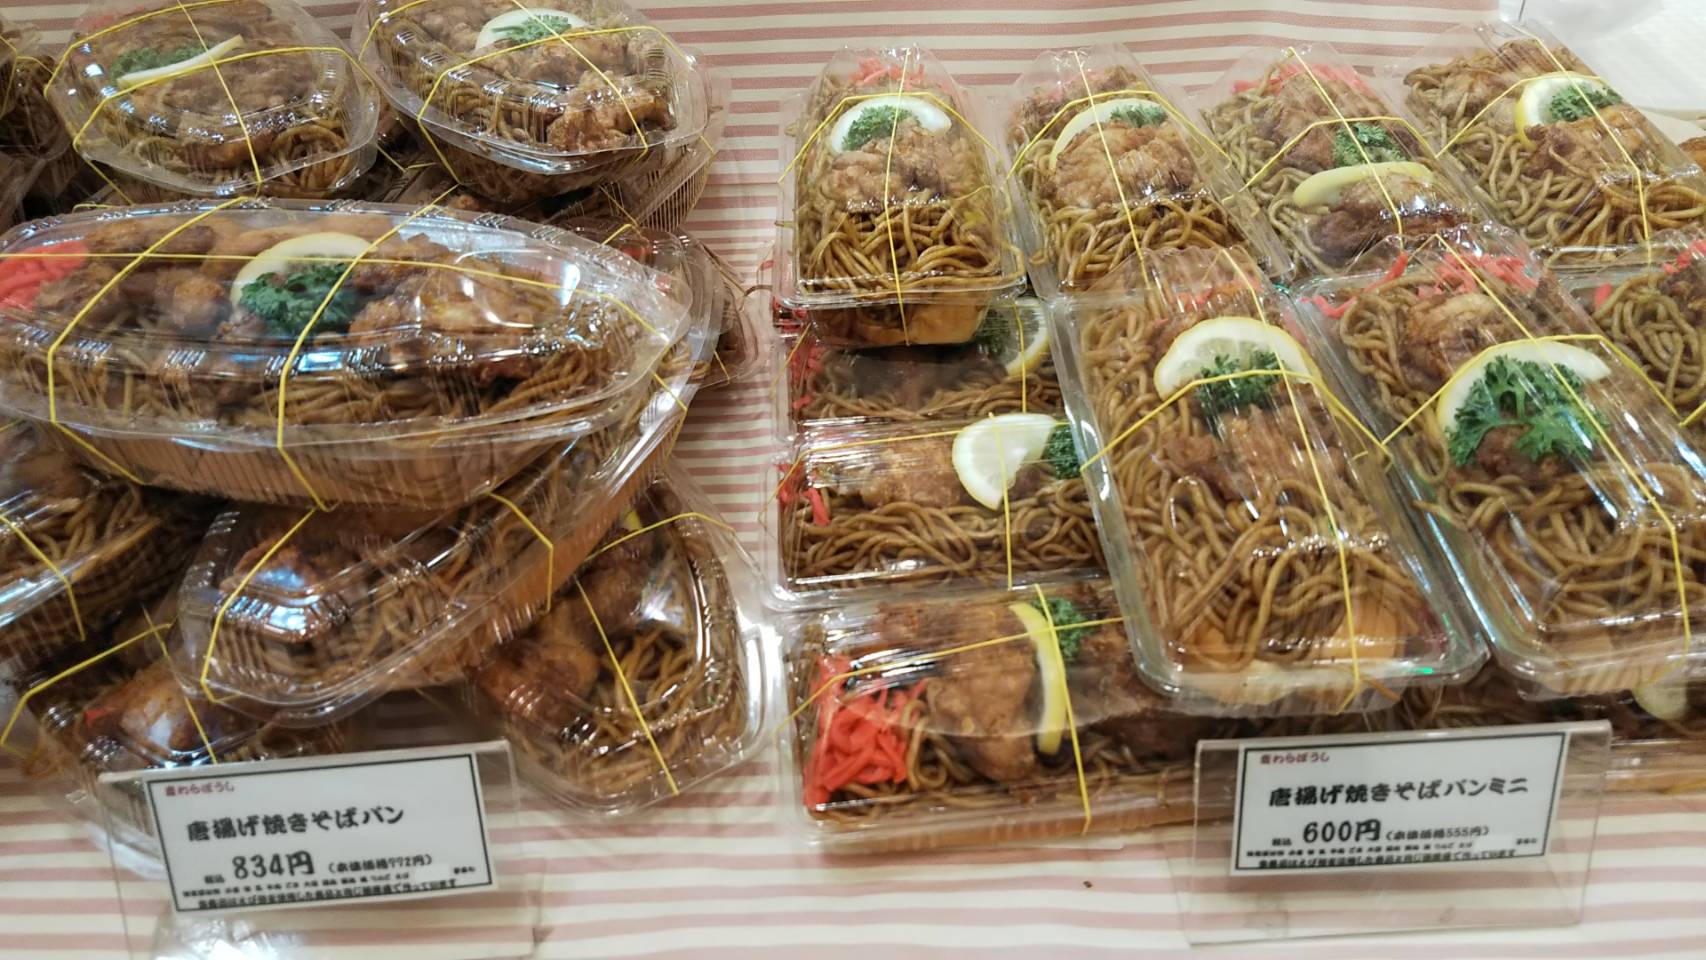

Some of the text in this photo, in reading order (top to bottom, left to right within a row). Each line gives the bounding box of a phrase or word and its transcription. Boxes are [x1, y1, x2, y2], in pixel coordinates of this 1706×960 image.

[186, 805, 405, 842] 唐揚げ焼きそばパン
[1302, 818, 1382, 844] 600円
[231, 849, 316, 880] 834円
